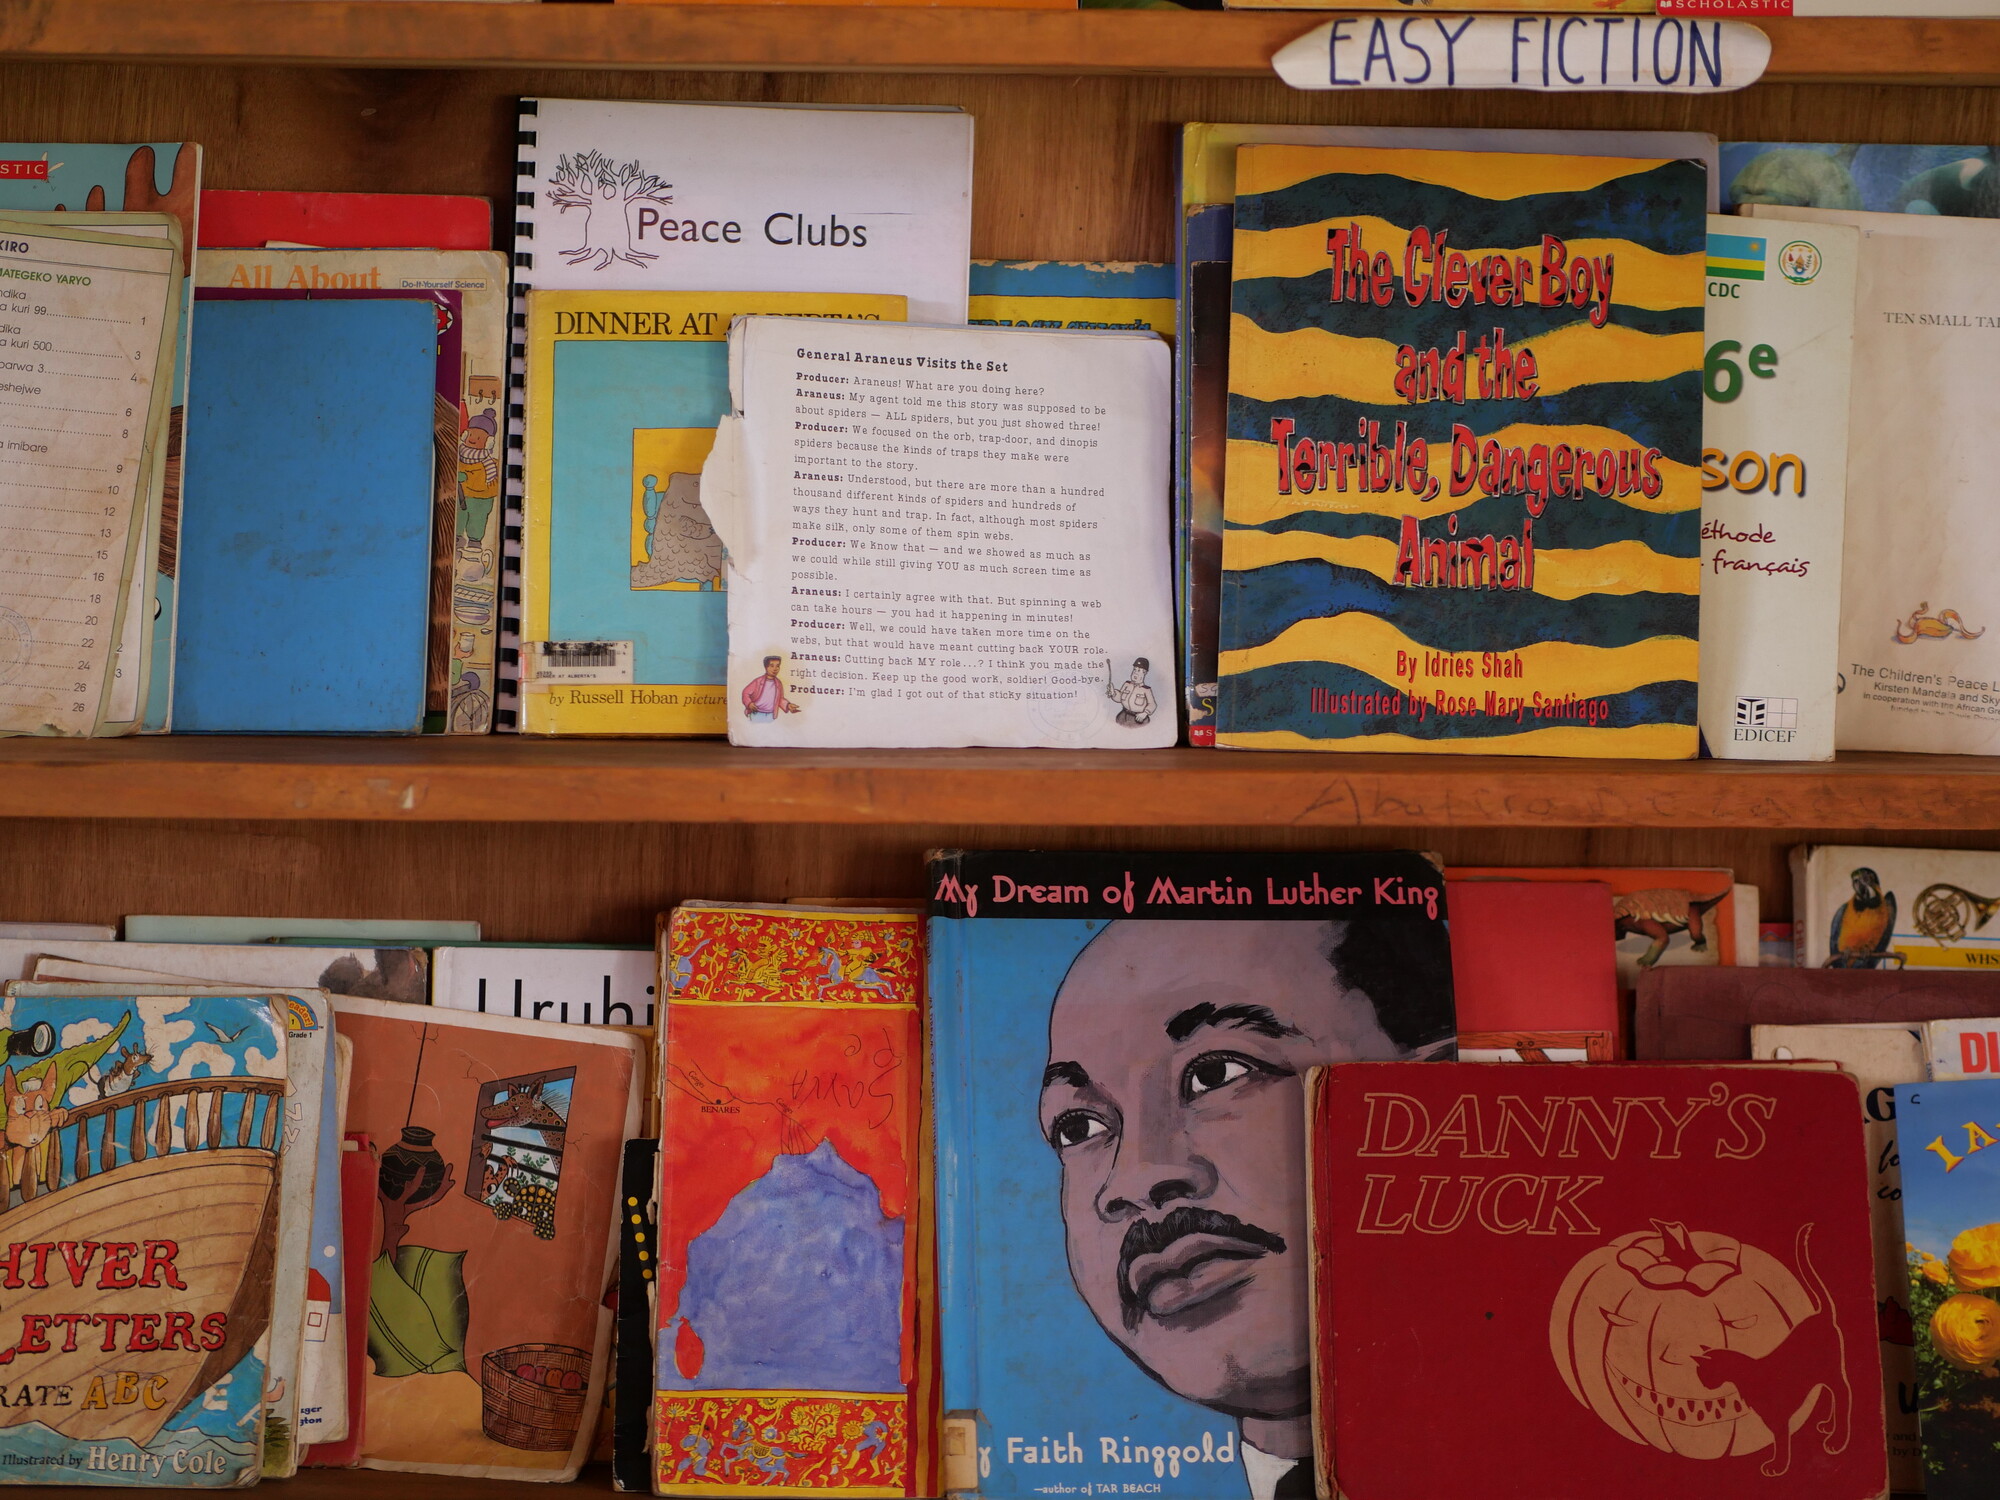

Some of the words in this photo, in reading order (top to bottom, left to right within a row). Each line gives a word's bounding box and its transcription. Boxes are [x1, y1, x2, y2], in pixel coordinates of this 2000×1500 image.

[1676, 0, 1790, 8] SCHOLASTIC
[1329, 17, 1475, 87] EASY
[1511, 17, 1722, 88] FICTION
[637, 207, 741, 243] Peace
[763, 211, 868, 248] Clubs
[56, 274, 91, 286] YARYO
[228, 264, 272, 289] All
[285, 265, 381, 289] About
[1326, 221, 1395, 307] The
[1403, 224, 1533, 308] Clever
[1539, 233, 1614, 328] Boy
[454, 281, 486, 289] Science
[1707, 281, 1741, 299] CDC
[12, 303, 30, 313] kuri
[141, 317, 147, 325] 1
[554, 311, 672, 335] DINNER
[679, 312, 718, 335] AT
[1883, 311, 1915, 325] TEN
[1919, 313, 1972, 327] SMALL
[11, 339, 29, 349] kuri
[135, 351, 141, 360] 3
[796, 348, 850, 361] General
[853, 352, 912, 366] Araneus
[916, 356, 956, 369] Visits
[960, 359, 982, 370] the
[986, 360, 1008, 372] Set
[1393, 330, 1467, 405] and
[1474, 327, 1541, 401] the
[130, 372, 138, 382] 4
[795, 371, 849, 384] Producer:
[853, 376, 901, 388] Araneus!
[905, 379, 933, 390] What
[936, 383, 954, 391] are
[957, 384, 979, 393] you
[981, 383, 1011, 396] doing
[1014, 385, 1044, 395] here?
[125, 408, 132, 417] 6
[122, 429, 129, 438] 8
[7, 441, 48, 453] imibare
[116, 465, 123, 474] 9
[794, 453, 847, 465] important
[850, 457, 861, 466] to
[865, 458, 882, 468] the
[886, 460, 917, 472] story.
[1270, 416, 1441, 501] Terrible,
[1449, 423, 1663, 518] Dangerous
[107, 485, 120, 495] 10
[103, 507, 116, 517] 12
[100, 529, 112, 538] 13
[792, 521, 821, 532] make
[825, 522, 848, 533] silk,
[851, 523, 876, 534] only
[879, 526, 907, 535] some
[911, 526, 922, 535] of
[926, 527, 952, 538] them
[957, 529, 979, 540] spin
[983, 530, 1013, 540] webs.
[96, 551, 108, 560] 15
[1392, 513, 1534, 591] Animal
[1712, 549, 1810, 577] français
[93, 572, 105, 582] 16
[791, 570, 837, 580] possible.
[89, 594, 101, 604] 18
[84, 615, 98, 626] 20
[790, 618, 845, 629] Producer:
[849, 621, 875, 632] Well,
[898, 624, 926, 633] could
[931, 625, 957, 635] have
[961, 626, 991, 636] taken
[996, 629, 1023, 637] more
[1027, 629, 1051, 640] time
[1071, 629, 1090, 638] the
[81, 638, 94, 648] 22
[77, 660, 91, 671] 24
[1396, 650, 1417, 683] By
[1425, 650, 1474, 678] Idries
[1481, 651, 1523, 679] Shah
[1851, 663, 1875, 678] The
[1879, 667, 1942, 686] Children's
[1948, 675, 1989, 691] Peace
[73, 682, 87, 693] 26
[789, 684, 844, 695] Producer:
[848, 687, 865, 696] I'm
[870, 688, 892, 699] glad
[897, 689, 901, 697] I
[905, 690, 922, 700] got
[926, 690, 944, 698] out
[947, 689, 958, 698] of
[962, 690, 985, 698] that
[989, 690, 1021, 700] sticky
[1026, 690, 1077, 699] situation!
[1874, 681, 1909, 695] Kirsten
[1959, 692, 1979, 703] and
[72, 703, 85, 712] 26
[549, 693, 565, 706] by
[570, 690, 624, 705] Russell
[630, 690, 678, 705] Hoban
[1310, 687, 1401, 715] Illustrated
[1408, 689, 1427, 723] by
[1435, 689, 1477, 717] Rose
[1485, 690, 1524, 724] Mary
[1532, 690, 1609, 726] Santiago
[1863, 692, 1871, 700] in
[1872, 694, 1920, 706] cooperation
[1922, 699, 1939, 708] with
[1956, 703, 1986, 714] African
[1734, 728, 1797, 743] EDICEF
[935, 873, 978, 918] My
[992, 875, 1088, 904] Dream
[1102, 871, 1135, 914] of
[1147, 876, 1252, 905] Martin
[1266, 872, 1363, 905] Luther
[1373, 876, 1439, 920] King
[701, 1105, 740, 1114] BENARES
[1357, 1081, 1777, 1161] DANNY'S
[1356, 1173, 1604, 1236] LUCK
[0, 1312, 228, 1365] ETTERS
[81, 1371, 169, 1410] ABC
[2, 1454, 64, 1466] Illustrated
[69, 1454, 83, 1469] by
[88, 1446, 167, 1478] Henry
[172, 1449, 227, 1475] Cole
[1007, 1431, 1083, 1464] Faith
[1099, 1431, 1235, 1478] Ringgold
[1080, 1482, 1093, 1497] of
[1096, 1483, 1118, 1494] TAR
[1122, 1483, 1161, 1494] BEACH
